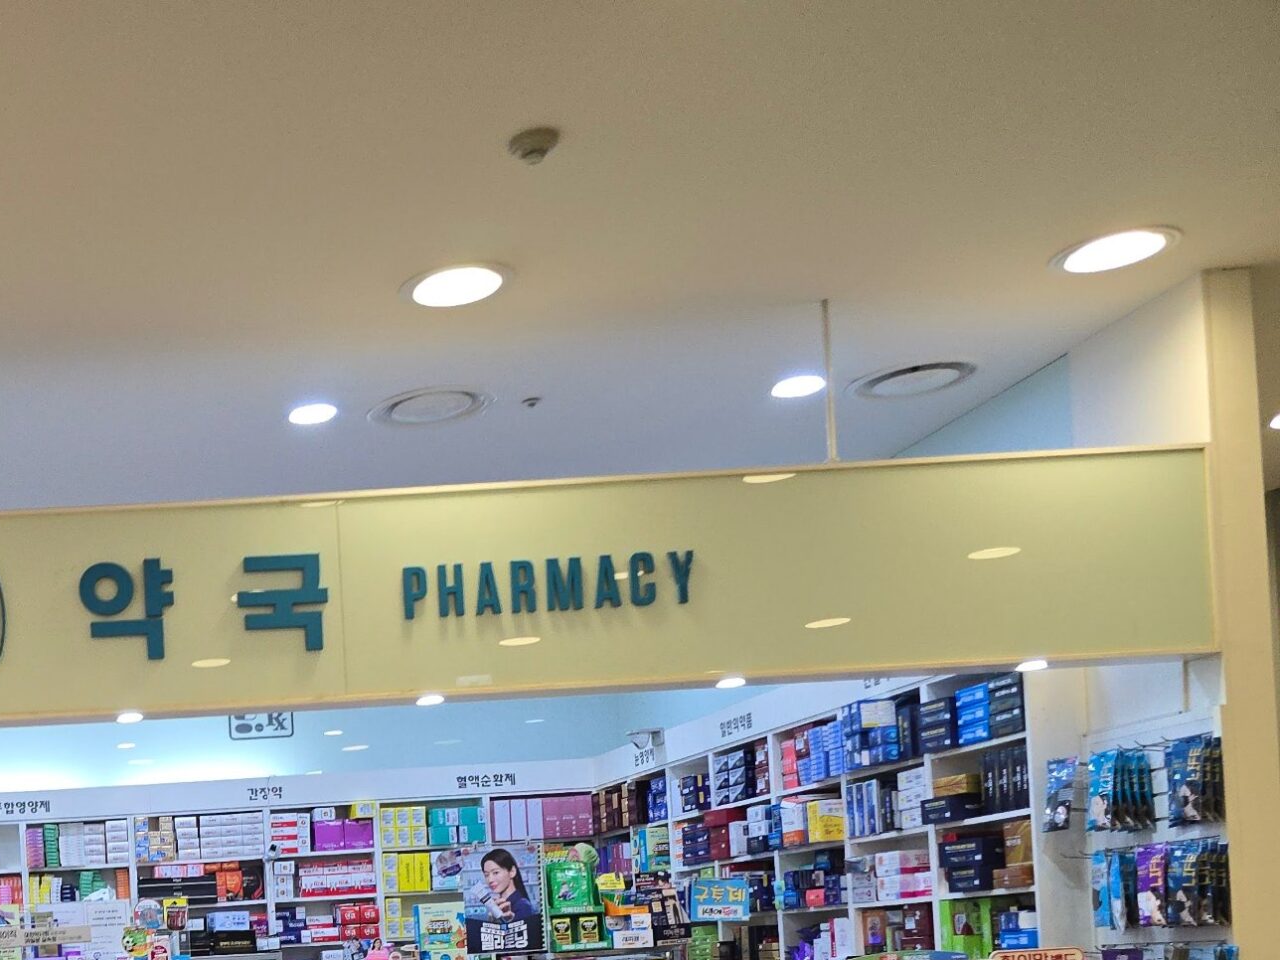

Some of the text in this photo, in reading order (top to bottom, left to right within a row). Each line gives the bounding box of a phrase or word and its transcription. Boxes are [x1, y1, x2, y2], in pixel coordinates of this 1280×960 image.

[402, 548, 694, 621] PHARMACY
[455, 772, 516, 789] 혈액순환제
[246, 785, 283, 801] 간장약
